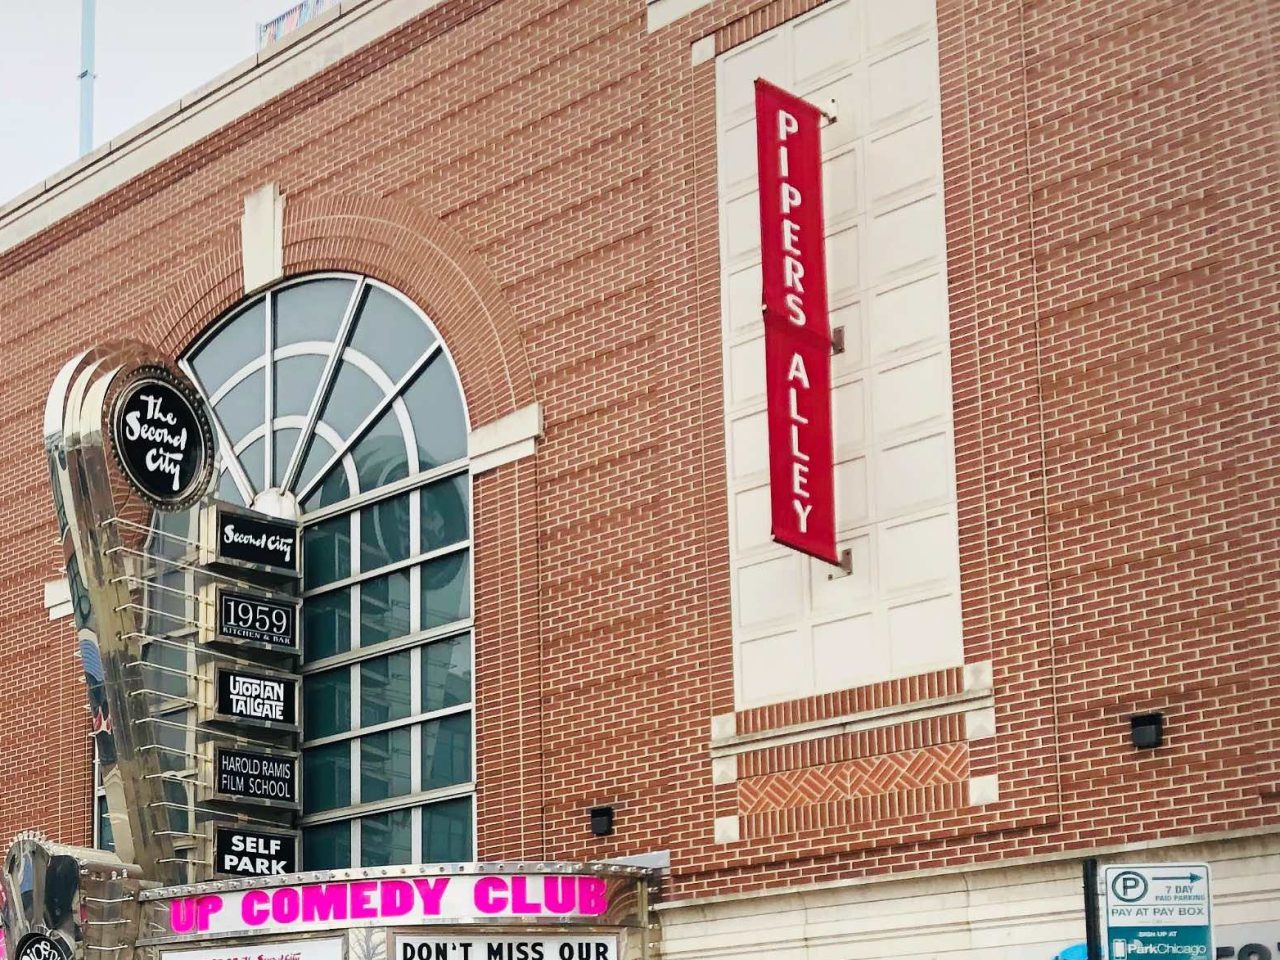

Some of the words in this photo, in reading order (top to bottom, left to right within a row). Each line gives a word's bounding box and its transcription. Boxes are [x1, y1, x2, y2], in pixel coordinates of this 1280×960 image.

[778, 109, 807, 326] PIPERS
[140, 395, 177, 425] The
[126, 411, 188, 451] Second
[788, 352, 813, 534] ALLEY
[145, 447, 183, 491] City
[223, 524, 267, 548] Second
[267, 536, 293, 562] City
[226, 601, 287, 634] 1959
[223, 627, 260, 640] KITCHEN
[273, 636, 290, 644] BAR
[230, 675, 284, 701] UTOPIAN
[230, 695, 284, 720] TAILGATE
[222, 755, 260, 775] HAROLD
[262, 760, 291, 779] RAMIS
[222, 774, 244, 792] FILM
[249, 778, 290, 798] SCHOOL
[231, 835, 281, 855] SELF
[224, 854, 287, 875] PARK
[1175, 886, 1194, 894] DAY
[170, 895, 223, 933] UP
[242, 877, 450, 926] COMEDY
[473, 875, 609, 916] CLUB
[1111, 908, 1132, 917] PAY
[1135, 908, 1149, 916] AT
[1153, 908, 1175, 916] PAY
[1178, 907, 1205, 916] BOX
[1128, 943, 1207, 956] ParkChicago
